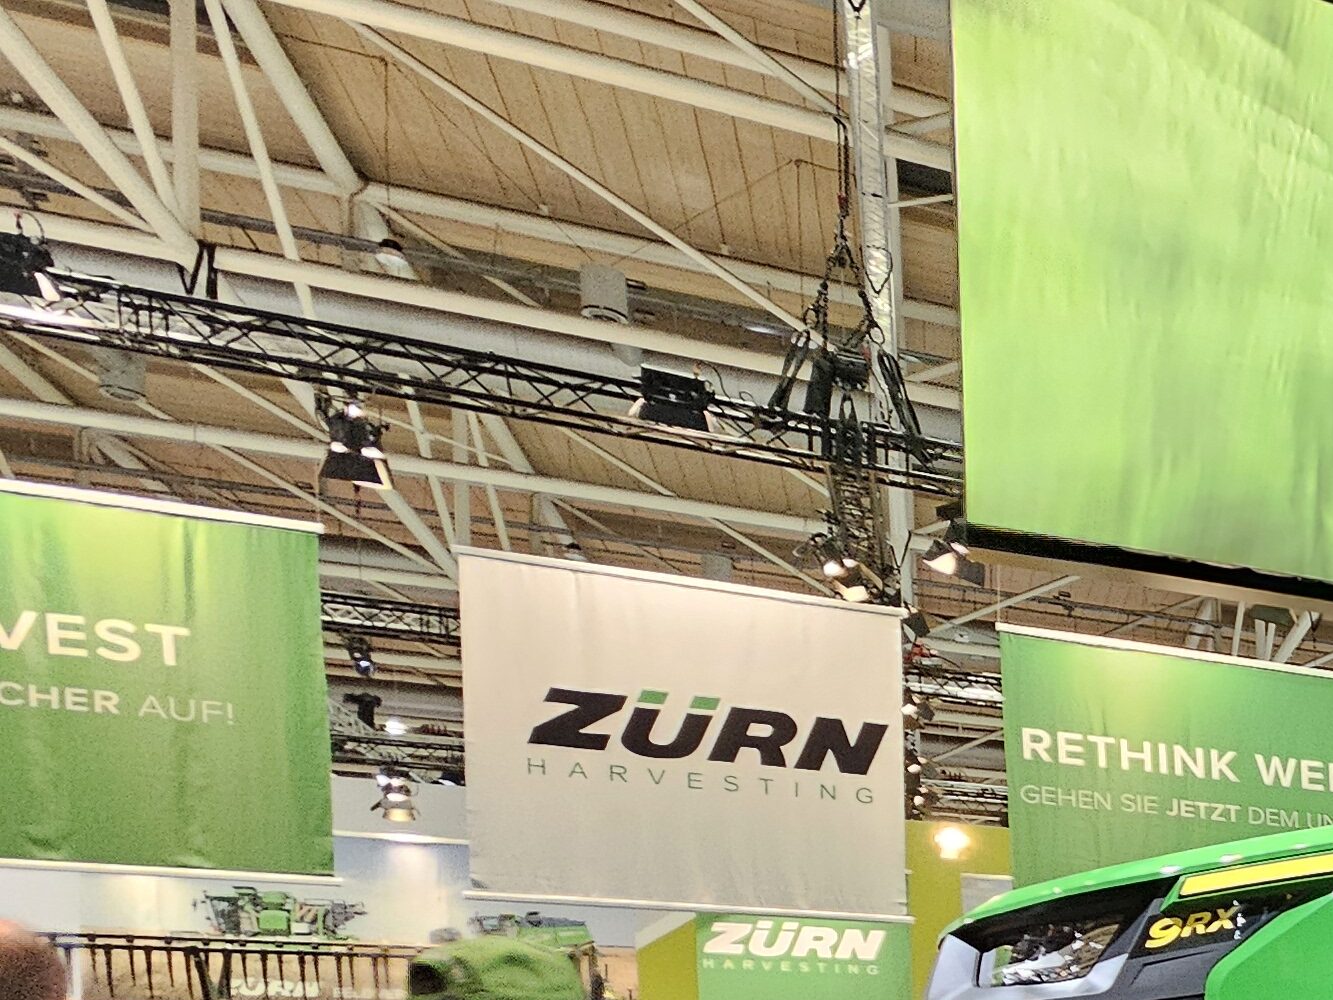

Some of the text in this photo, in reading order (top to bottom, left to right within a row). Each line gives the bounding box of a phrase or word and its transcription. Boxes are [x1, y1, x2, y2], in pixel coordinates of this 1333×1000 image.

[138, 695, 236, 725] AUF!
[527, 687, 889, 776] ZÜRN
[1021, 727, 1241, 783] RETHINK
[526, 757, 875, 805] HARVESTING
[1020, 784, 1112, 811] GEHEN
[1119, 793, 1159, 815] SIE
[1165, 798, 1241, 823] JETZT
[1247, 806, 1299, 829] DEM
[702, 919, 887, 961] ZÜRN
[1145, 905, 1240, 949] 9RX
[702, 957, 881, 975] HARVESTING
